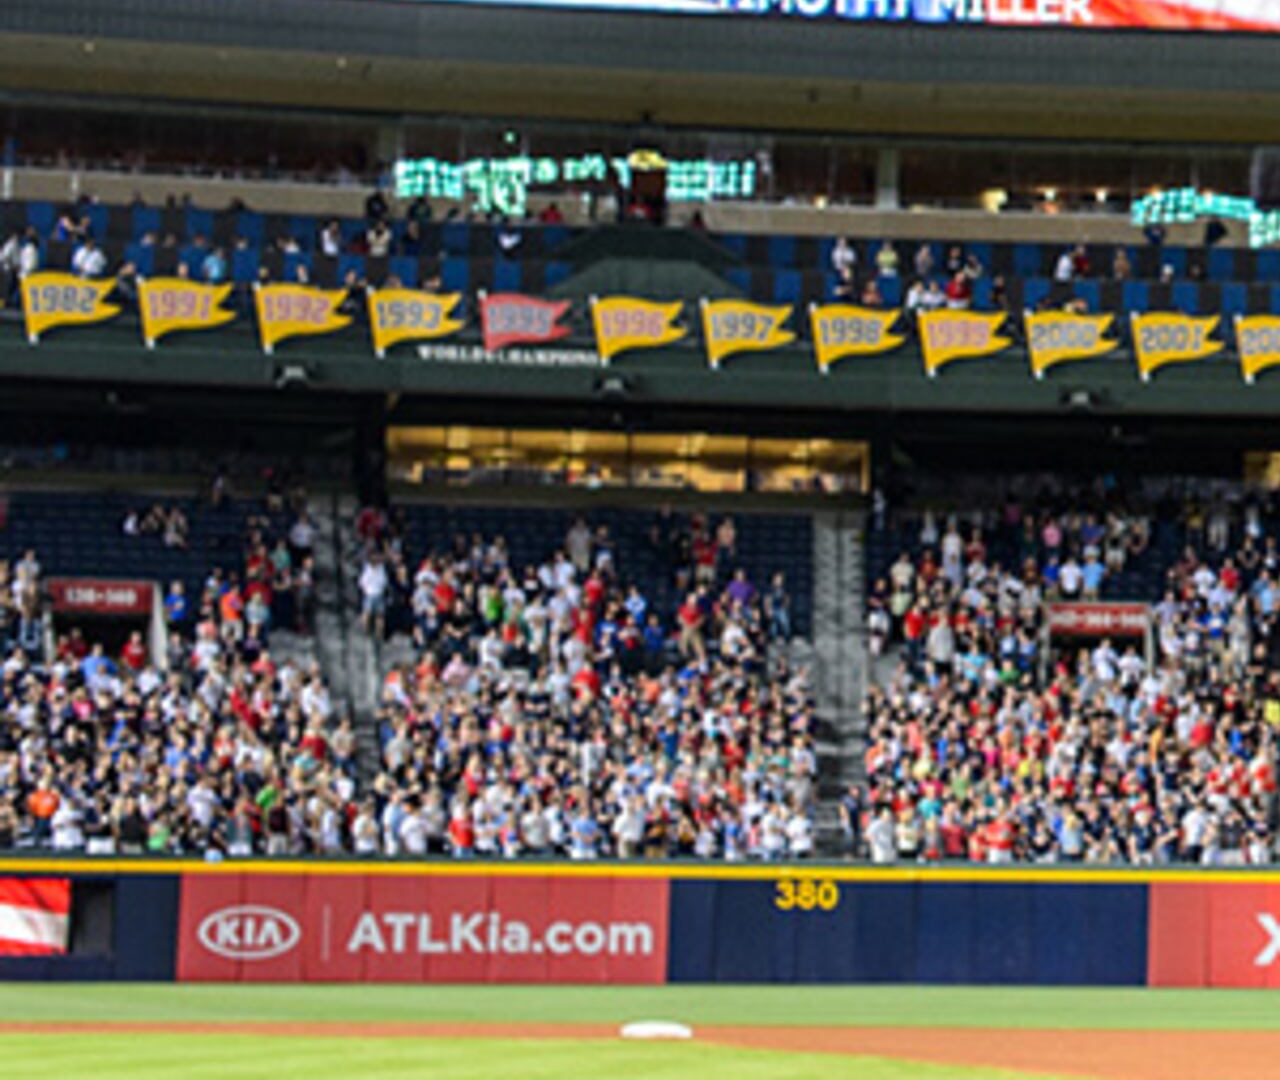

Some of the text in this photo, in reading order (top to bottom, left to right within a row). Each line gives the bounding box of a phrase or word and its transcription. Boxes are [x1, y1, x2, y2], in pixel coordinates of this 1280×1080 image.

[29, 284, 98, 314] 1982
[711, 311, 775, 342] 1997
[818, 317, 884, 345] 1998
[1139, 324, 1204, 353] 2001
[775, 879, 839, 910] 380
[216, 918, 284, 949] KIA
[346, 912, 654, 955] ATLKia.com
